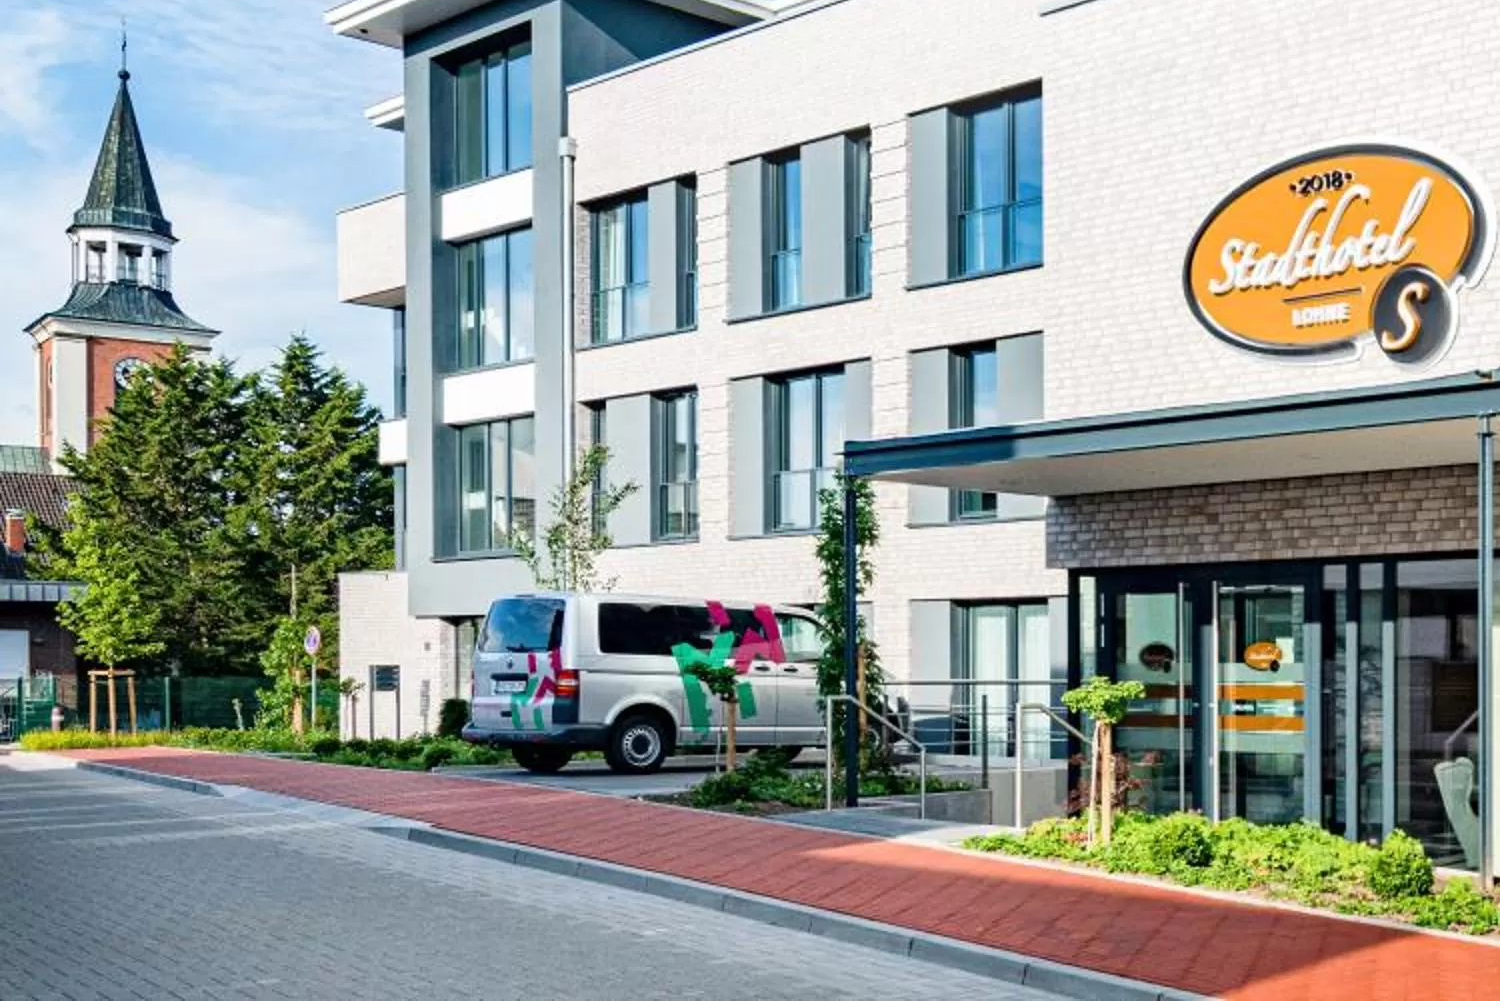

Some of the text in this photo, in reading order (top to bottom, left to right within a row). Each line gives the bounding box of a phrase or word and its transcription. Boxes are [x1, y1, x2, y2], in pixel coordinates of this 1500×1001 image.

[1299, 170, 1343, 196] 2018
[1208, 177, 1433, 294] Stadthotel
[1382, 281, 1429, 351] S
